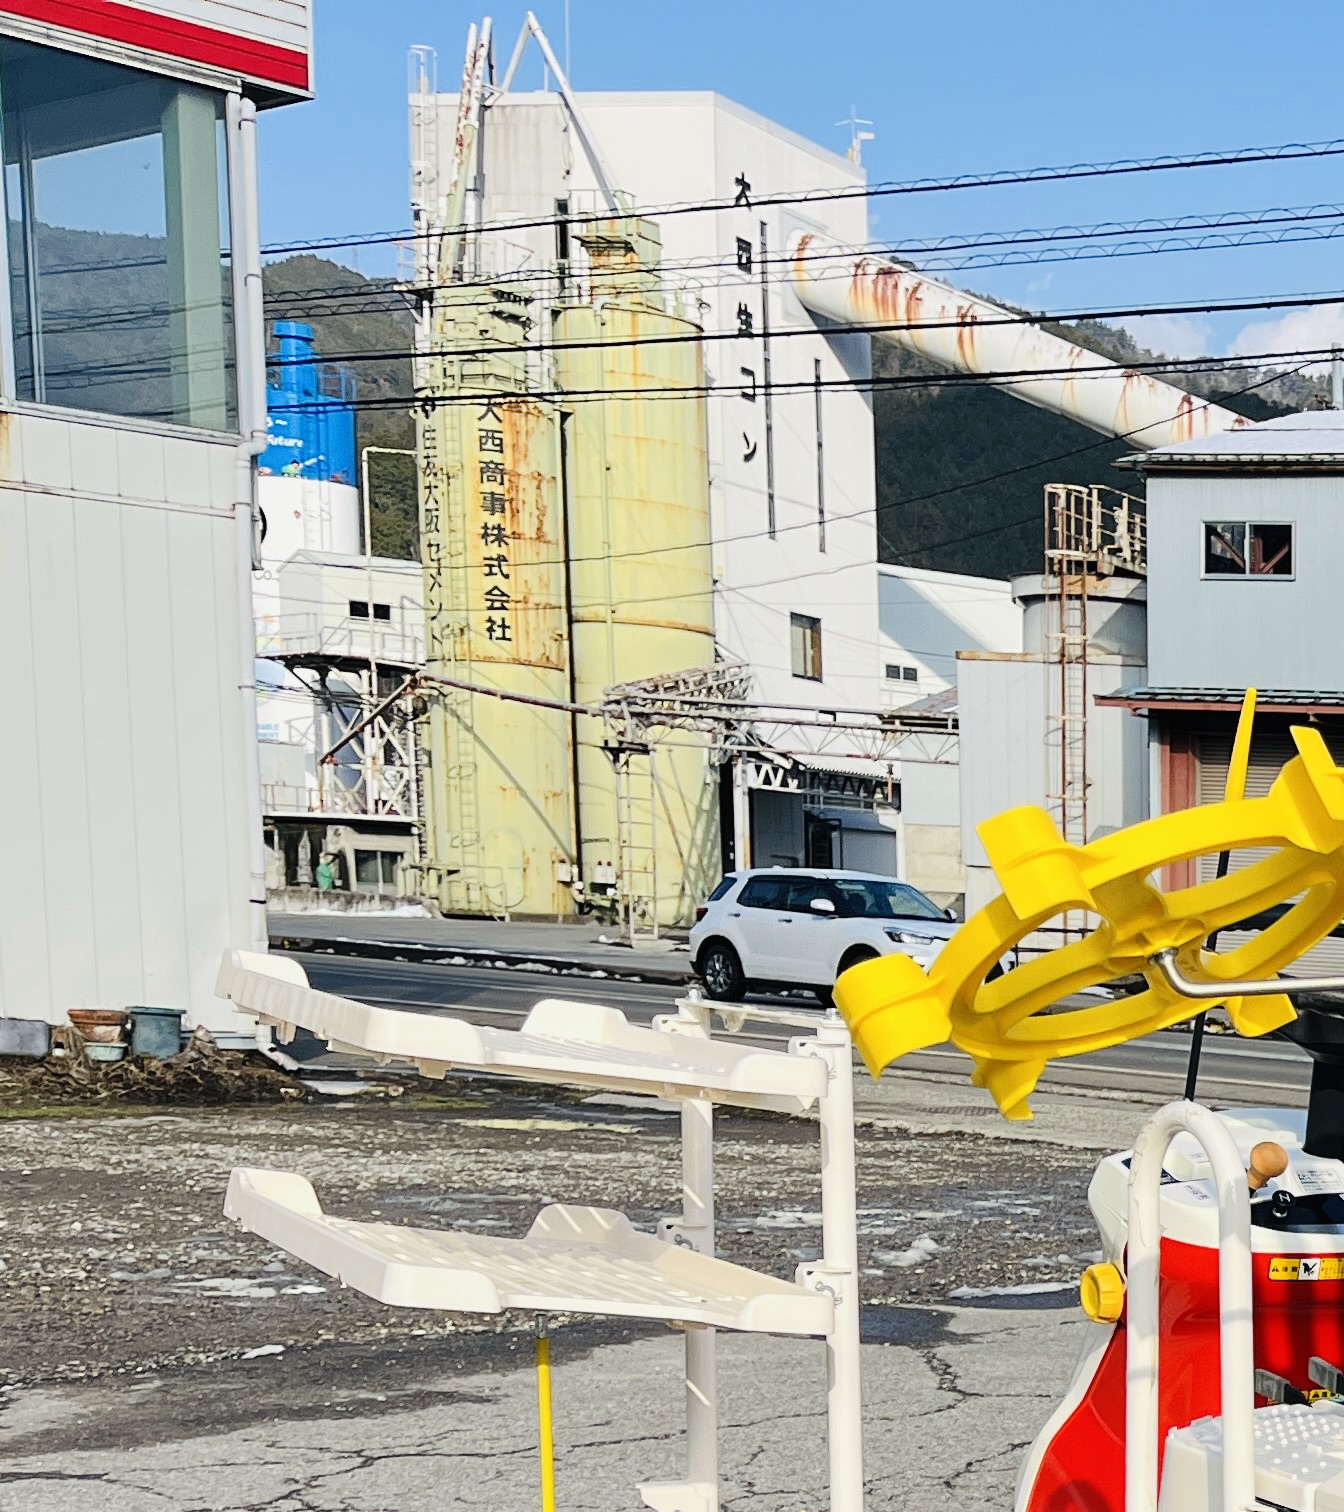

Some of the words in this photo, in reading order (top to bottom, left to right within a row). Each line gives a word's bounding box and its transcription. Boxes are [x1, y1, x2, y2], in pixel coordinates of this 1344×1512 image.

[734, 171, 757, 463] 大西生コン
[477, 398, 512, 642] 大西商事株式会社
